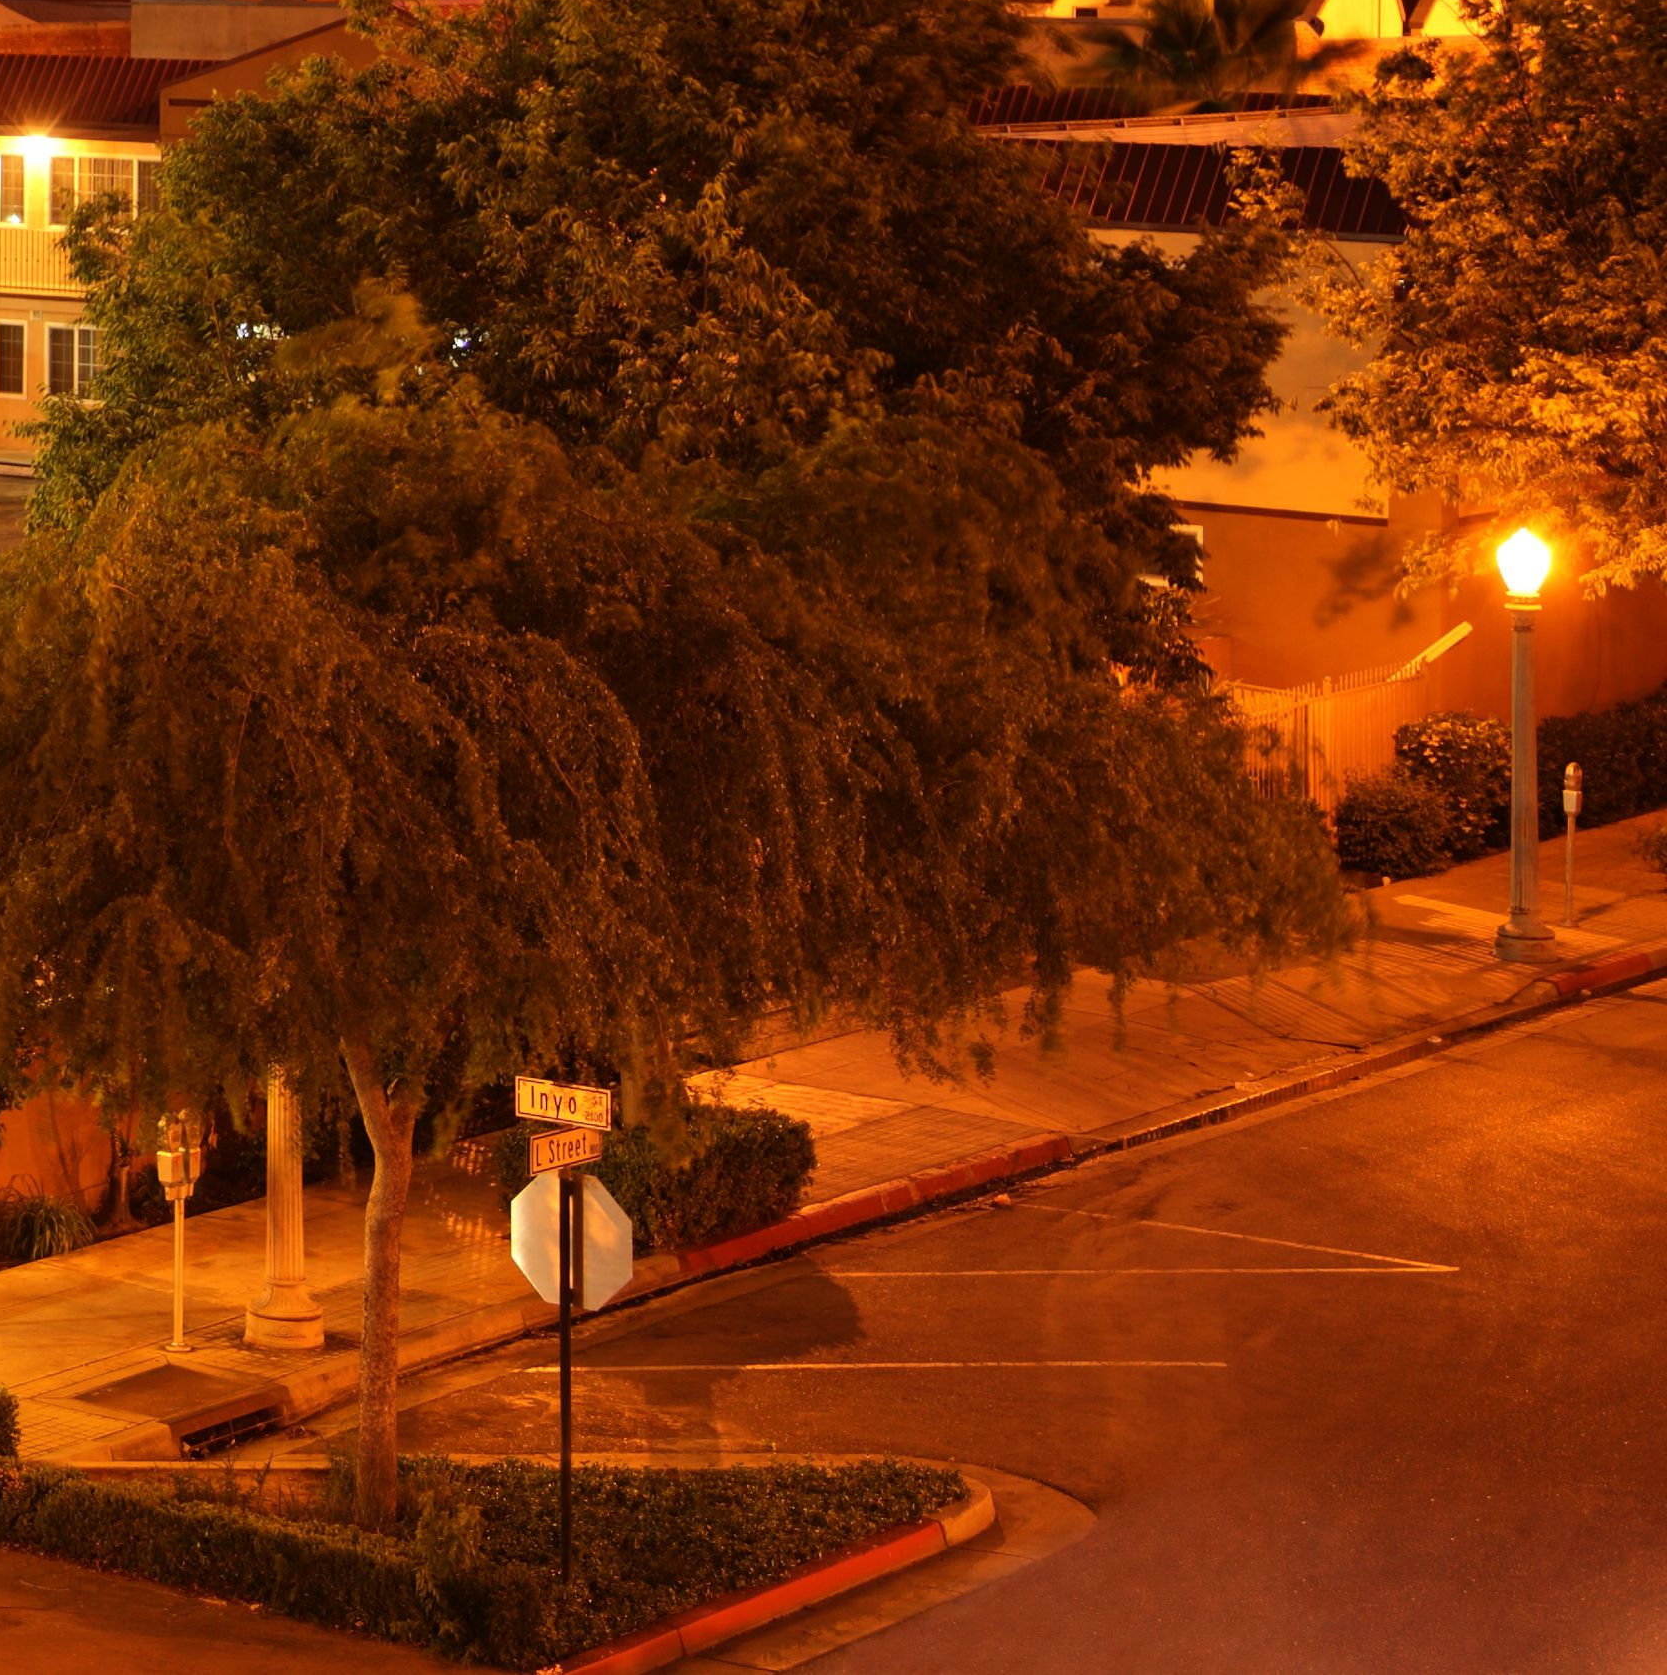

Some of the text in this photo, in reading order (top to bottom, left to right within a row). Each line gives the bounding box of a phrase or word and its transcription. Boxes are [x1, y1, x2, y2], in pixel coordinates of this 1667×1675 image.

[531, 1085, 577, 1119] Inyo
[536, 1144, 541, 1166] L
[548, 1132, 587, 1164] Street
